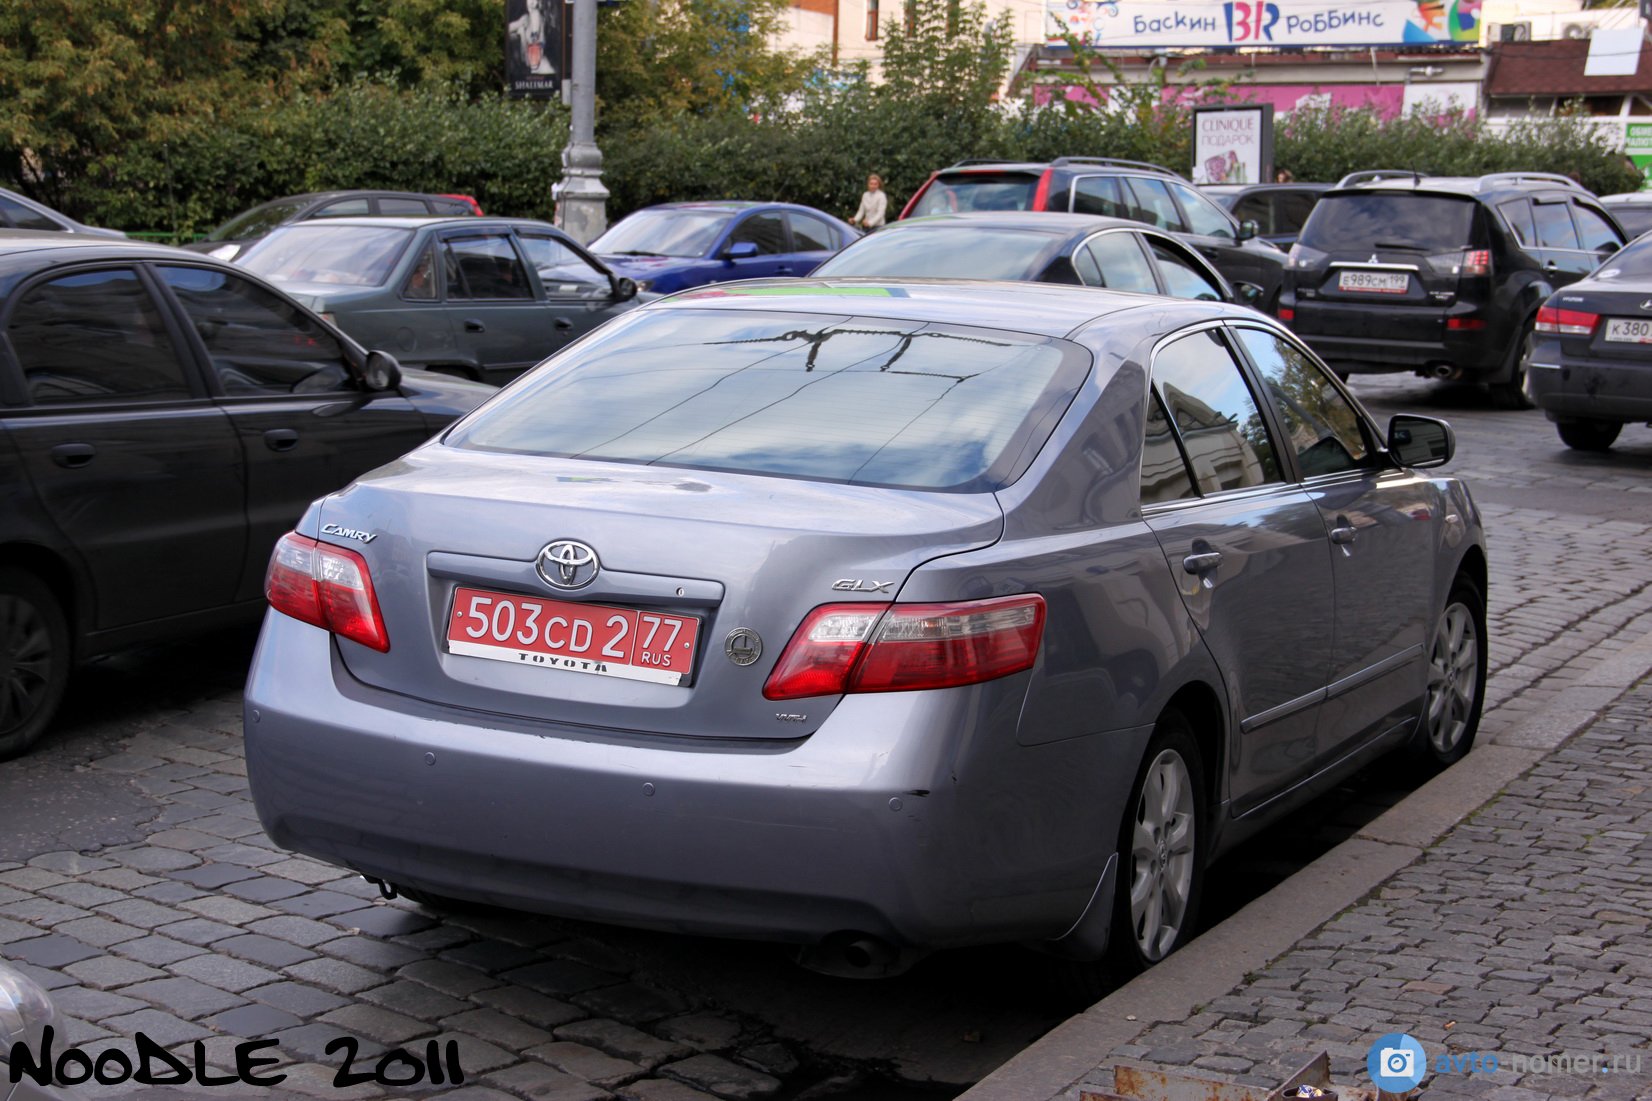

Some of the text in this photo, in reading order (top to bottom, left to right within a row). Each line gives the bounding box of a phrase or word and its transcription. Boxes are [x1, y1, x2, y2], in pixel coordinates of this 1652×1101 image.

[1133, 11, 1216, 34] Баскин
[1202, 117, 1254, 132] CLINIQUE
[1201, 134, 1255, 146] ПОДАРОК
[1611, 321, 1652, 336] К380
[320, 523, 378, 544] CAMRY
[831, 578, 895, 594] GLX
[642, 616, 683, 652] 77
[517, 652, 608, 673] TOYOTA
[641, 651, 672, 667] RUS
